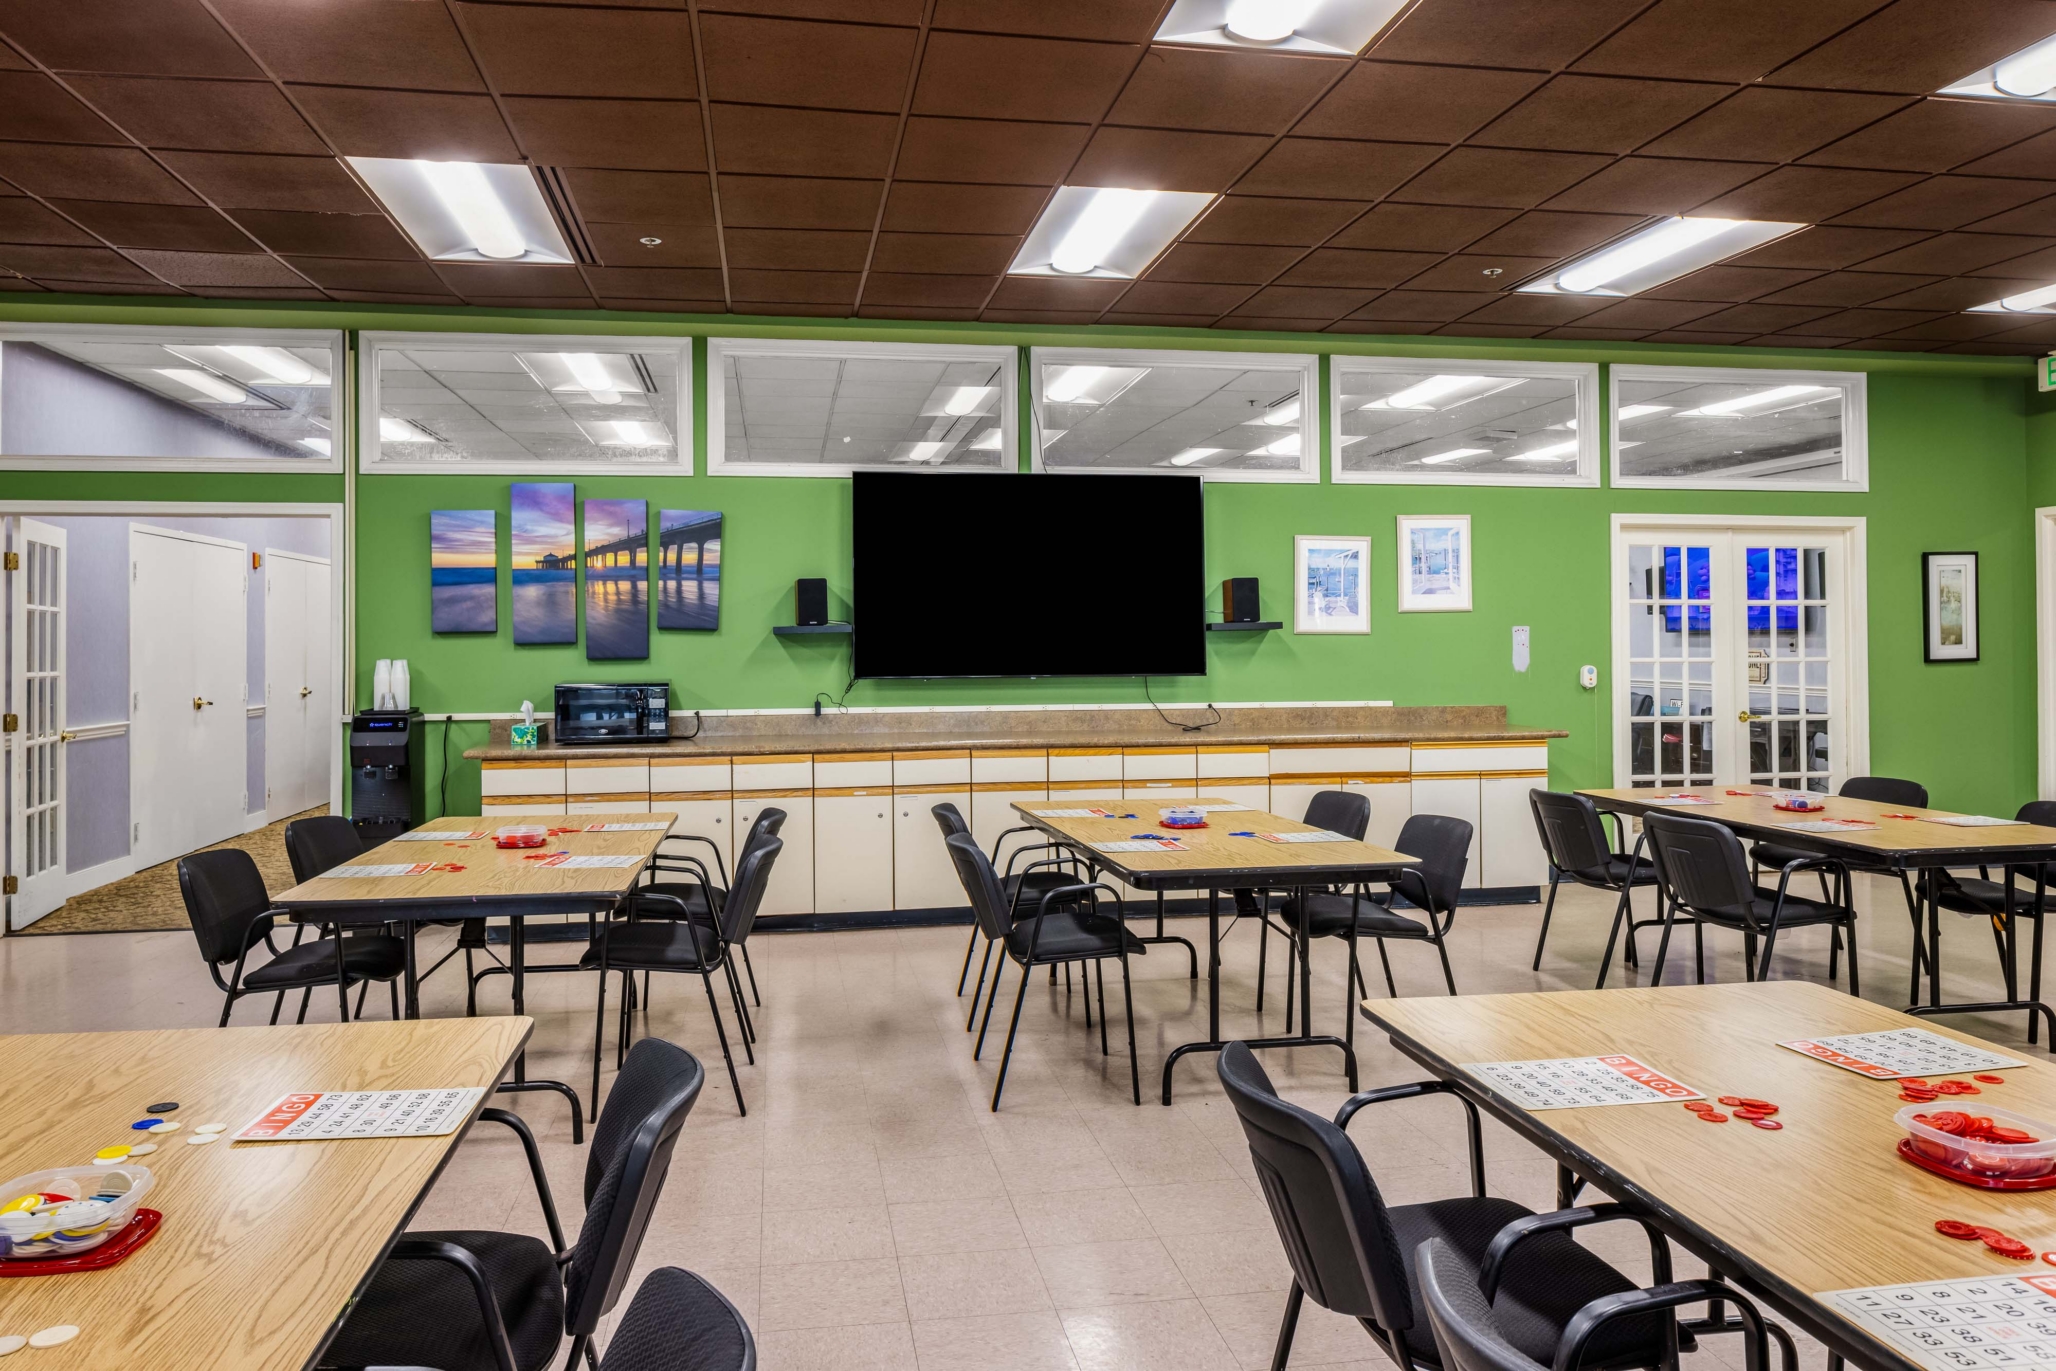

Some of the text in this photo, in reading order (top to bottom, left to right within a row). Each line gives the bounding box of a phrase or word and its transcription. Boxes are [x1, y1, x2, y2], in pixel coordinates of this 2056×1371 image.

[1604, 1057, 1687, 1097] BINGO
[356, 1094, 372, 1102] 62
[1524, 1090, 1540, 1098] 49
[248, 1094, 315, 1137] BINGO
[288, 1128, 304, 1136] 13
[308, 1112, 324, 1120] 44
[2002, 1282, 2029, 1294] 14
[1956, 1306, 1987, 1319] 21
[1993, 1303, 2025, 1317] 20
[2027, 1322, 2056, 1336] 39
[1856, 1295, 1882, 1306] 11
[1881, 1312, 1914, 1326] 27
[1912, 1332, 1944, 1346] 33
[1944, 1352, 1977, 1366] 53
[1918, 1309, 1950, 1323] 23
[1951, 1328, 1983, 1343] 38
[1984, 1348, 2015, 1361] 51
